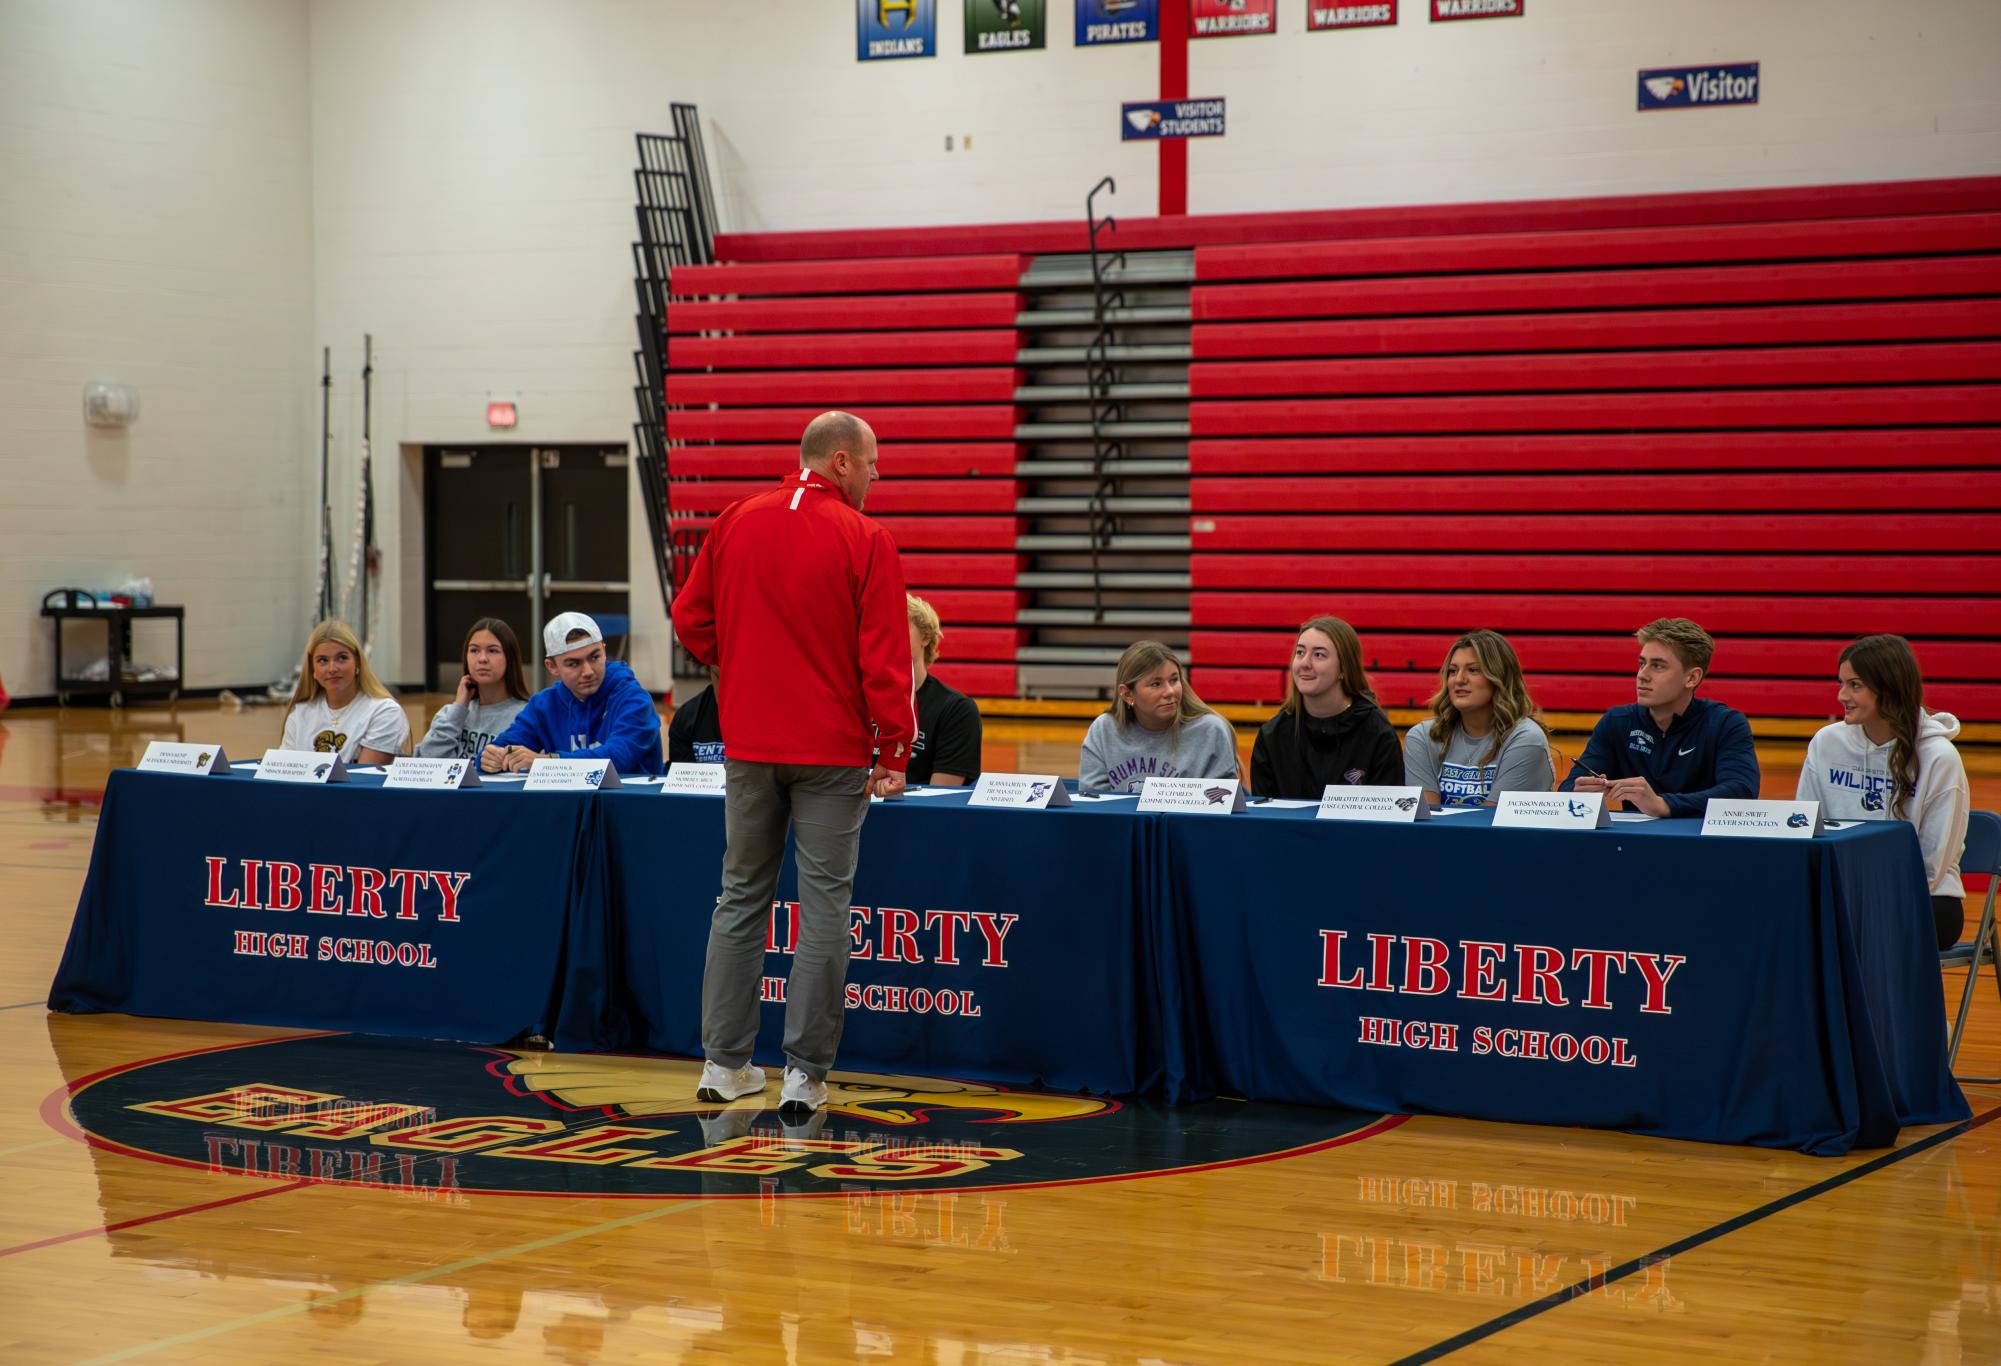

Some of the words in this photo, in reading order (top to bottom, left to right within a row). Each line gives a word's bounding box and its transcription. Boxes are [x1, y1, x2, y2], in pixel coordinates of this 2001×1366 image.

[1195, 15, 1270, 34] WARRIORS
[1314, 4, 1390, 25] WARRIORS
[978, 29, 1030, 49] EAGLES
[1087, 21, 1146, 41] PIRATES
[868, 38, 924, 57] INDIANS
[1686, 69, 1757, 103] Visitor
[1175, 101, 1224, 118] VISITOR
[1159, 118, 1225, 136] STUDENTS
[1109, 756, 1157, 790] RUMAN
[1439, 781, 1491, 796] SOFTBAL
[1738, 819, 1779, 827] STOCKTON
[204, 856, 471, 922] LIBERTY
[716, 896, 1019, 968] IERTY
[233, 930, 310, 959] HIGH
[317, 936, 438, 968] SCHOOL
[1317, 928, 1687, 1015] LIBERTY
[844, 983, 982, 1017] SCHOOL
[1358, 1016, 1459, 1052] HIGH
[1472, 1026, 1638, 1068] SCHOOL
[123, 1083, 1026, 1179] EAGLES
